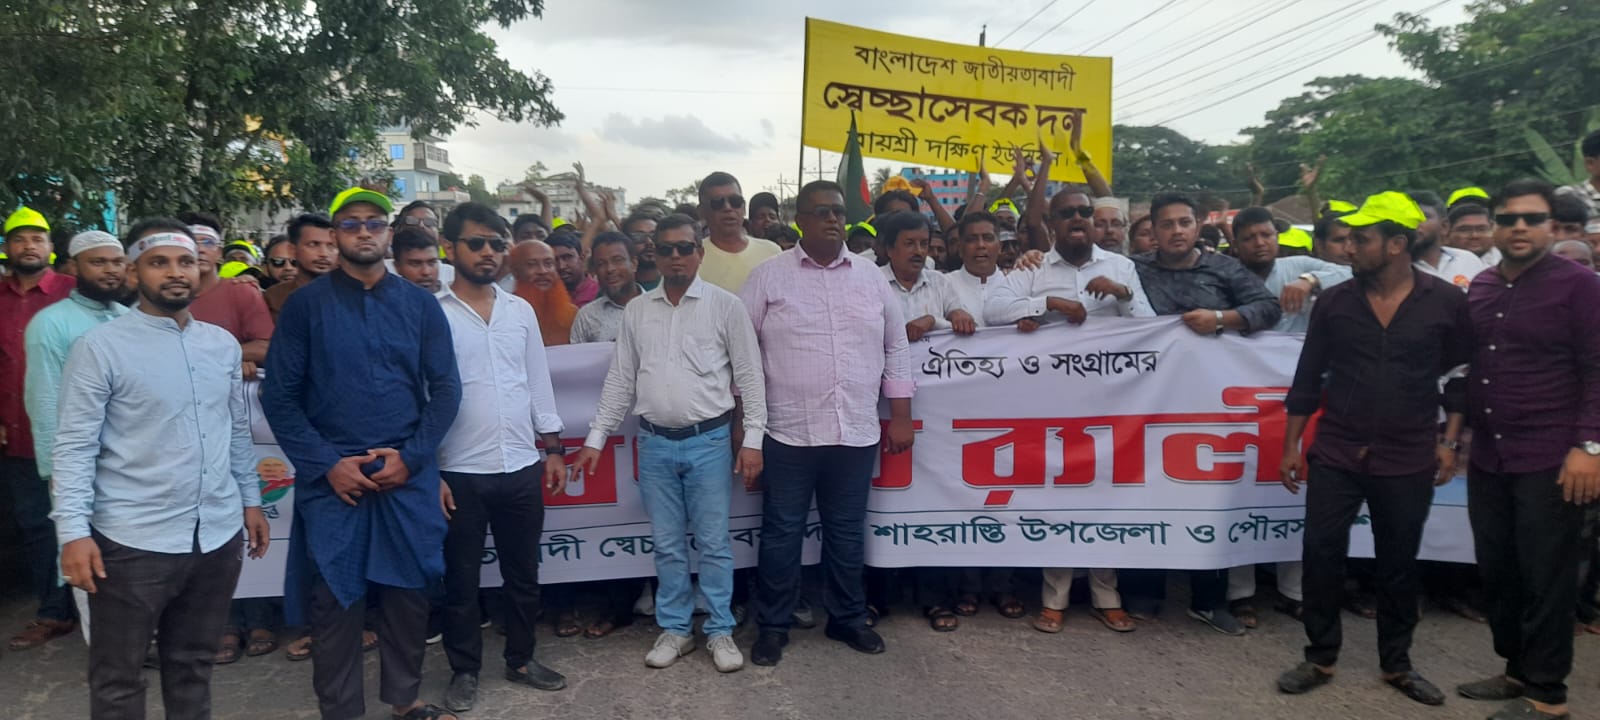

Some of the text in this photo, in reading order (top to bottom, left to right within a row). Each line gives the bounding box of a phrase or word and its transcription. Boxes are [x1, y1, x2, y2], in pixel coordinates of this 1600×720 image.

[854, 45, 1076, 91] বাংলাদেশ জাতীয়তাবাদী
[823, 81, 1028, 129] স্বেচ্ছাসেবক
[925, 135, 987, 162] দক্ষিণ
[921, 346, 1160, 379] ঐতিহ্য ও সংগ্রামের
[871, 516, 1006, 546] শাহরাস্তি
[1017, 515, 1171, 545] উপজেলা
[1186, 524, 1215, 543] ও
